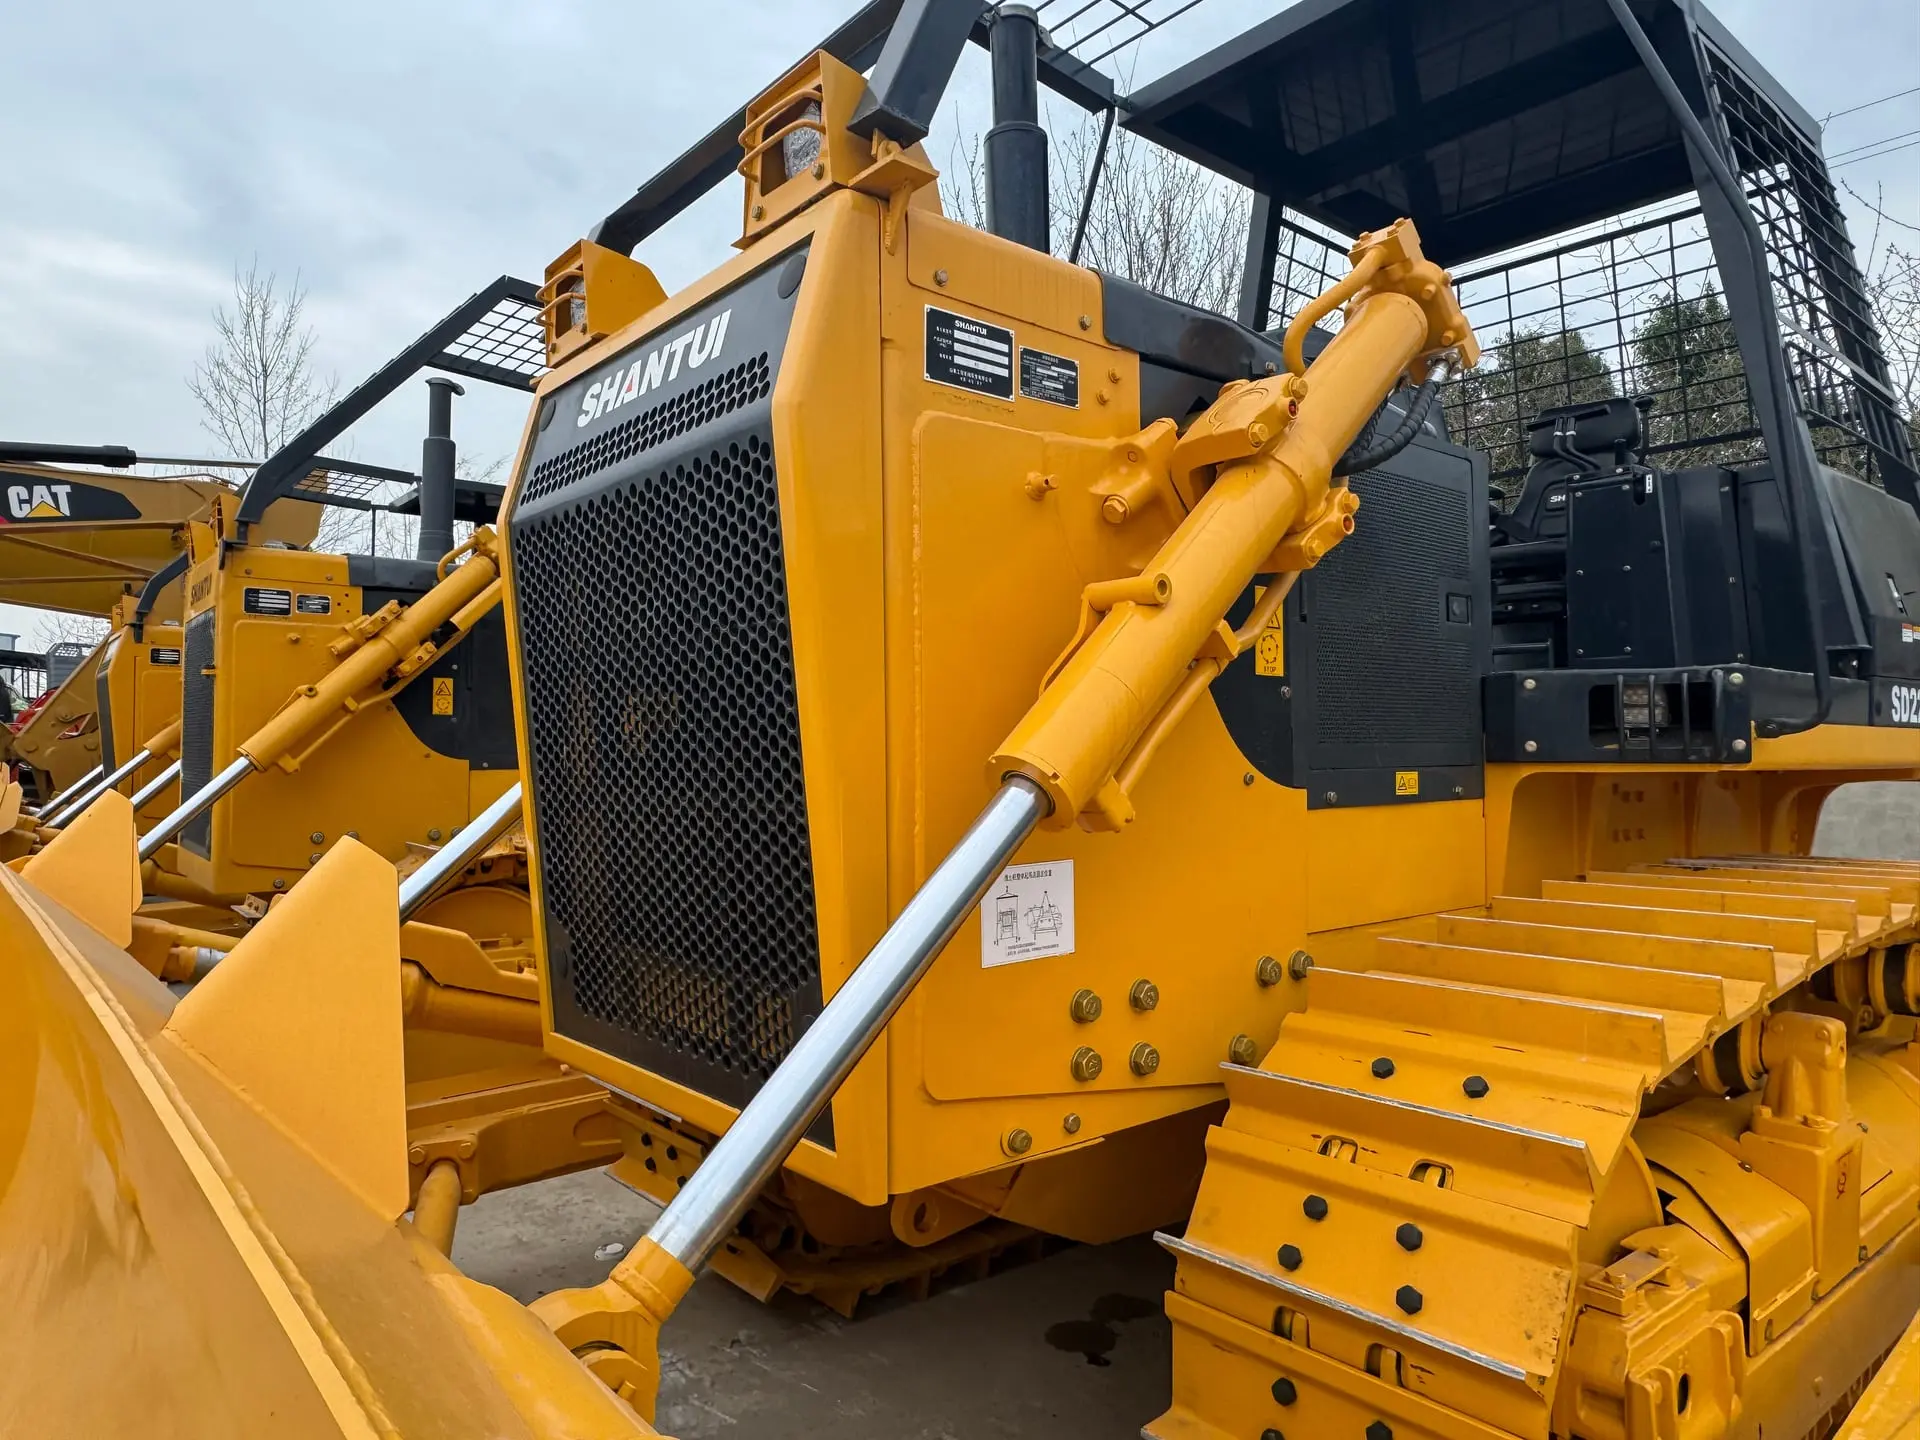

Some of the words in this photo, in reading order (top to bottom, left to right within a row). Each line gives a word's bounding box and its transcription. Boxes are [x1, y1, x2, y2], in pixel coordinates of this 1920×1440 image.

[955, 320, 987, 336] SHANTUI
[577, 309, 732, 428] SHANTUI
[7, 485, 72, 518] CAT
[1263, 665, 1277, 673] STOP
[1891, 685, 1920, 723] SD2
